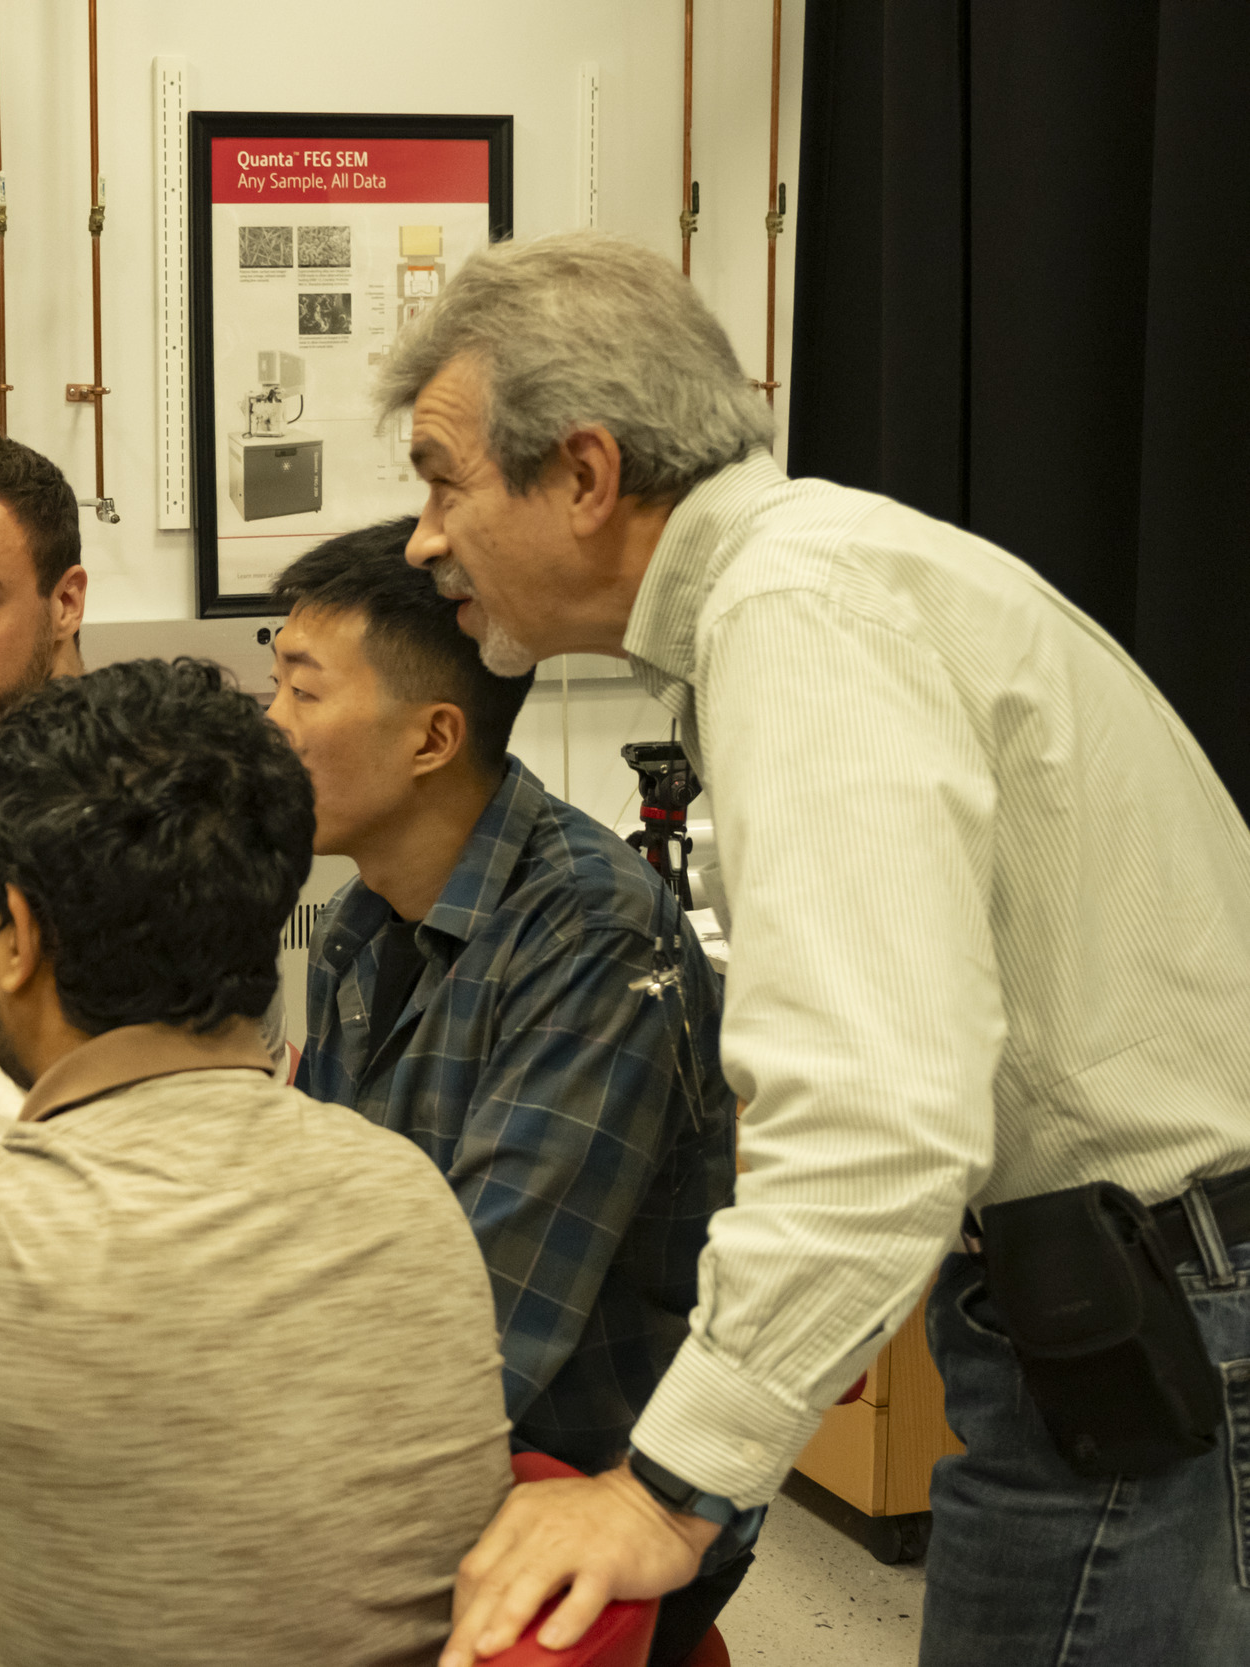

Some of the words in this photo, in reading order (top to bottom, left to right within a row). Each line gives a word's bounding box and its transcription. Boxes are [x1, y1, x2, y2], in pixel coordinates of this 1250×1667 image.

[304, 151, 332, 168] FEG
[336, 152, 368, 168] SEM
[237, 173, 265, 194] Any
[270, 173, 327, 192] Sample,
[332, 172, 350, 189] All
[353, 173, 386, 189] Data
